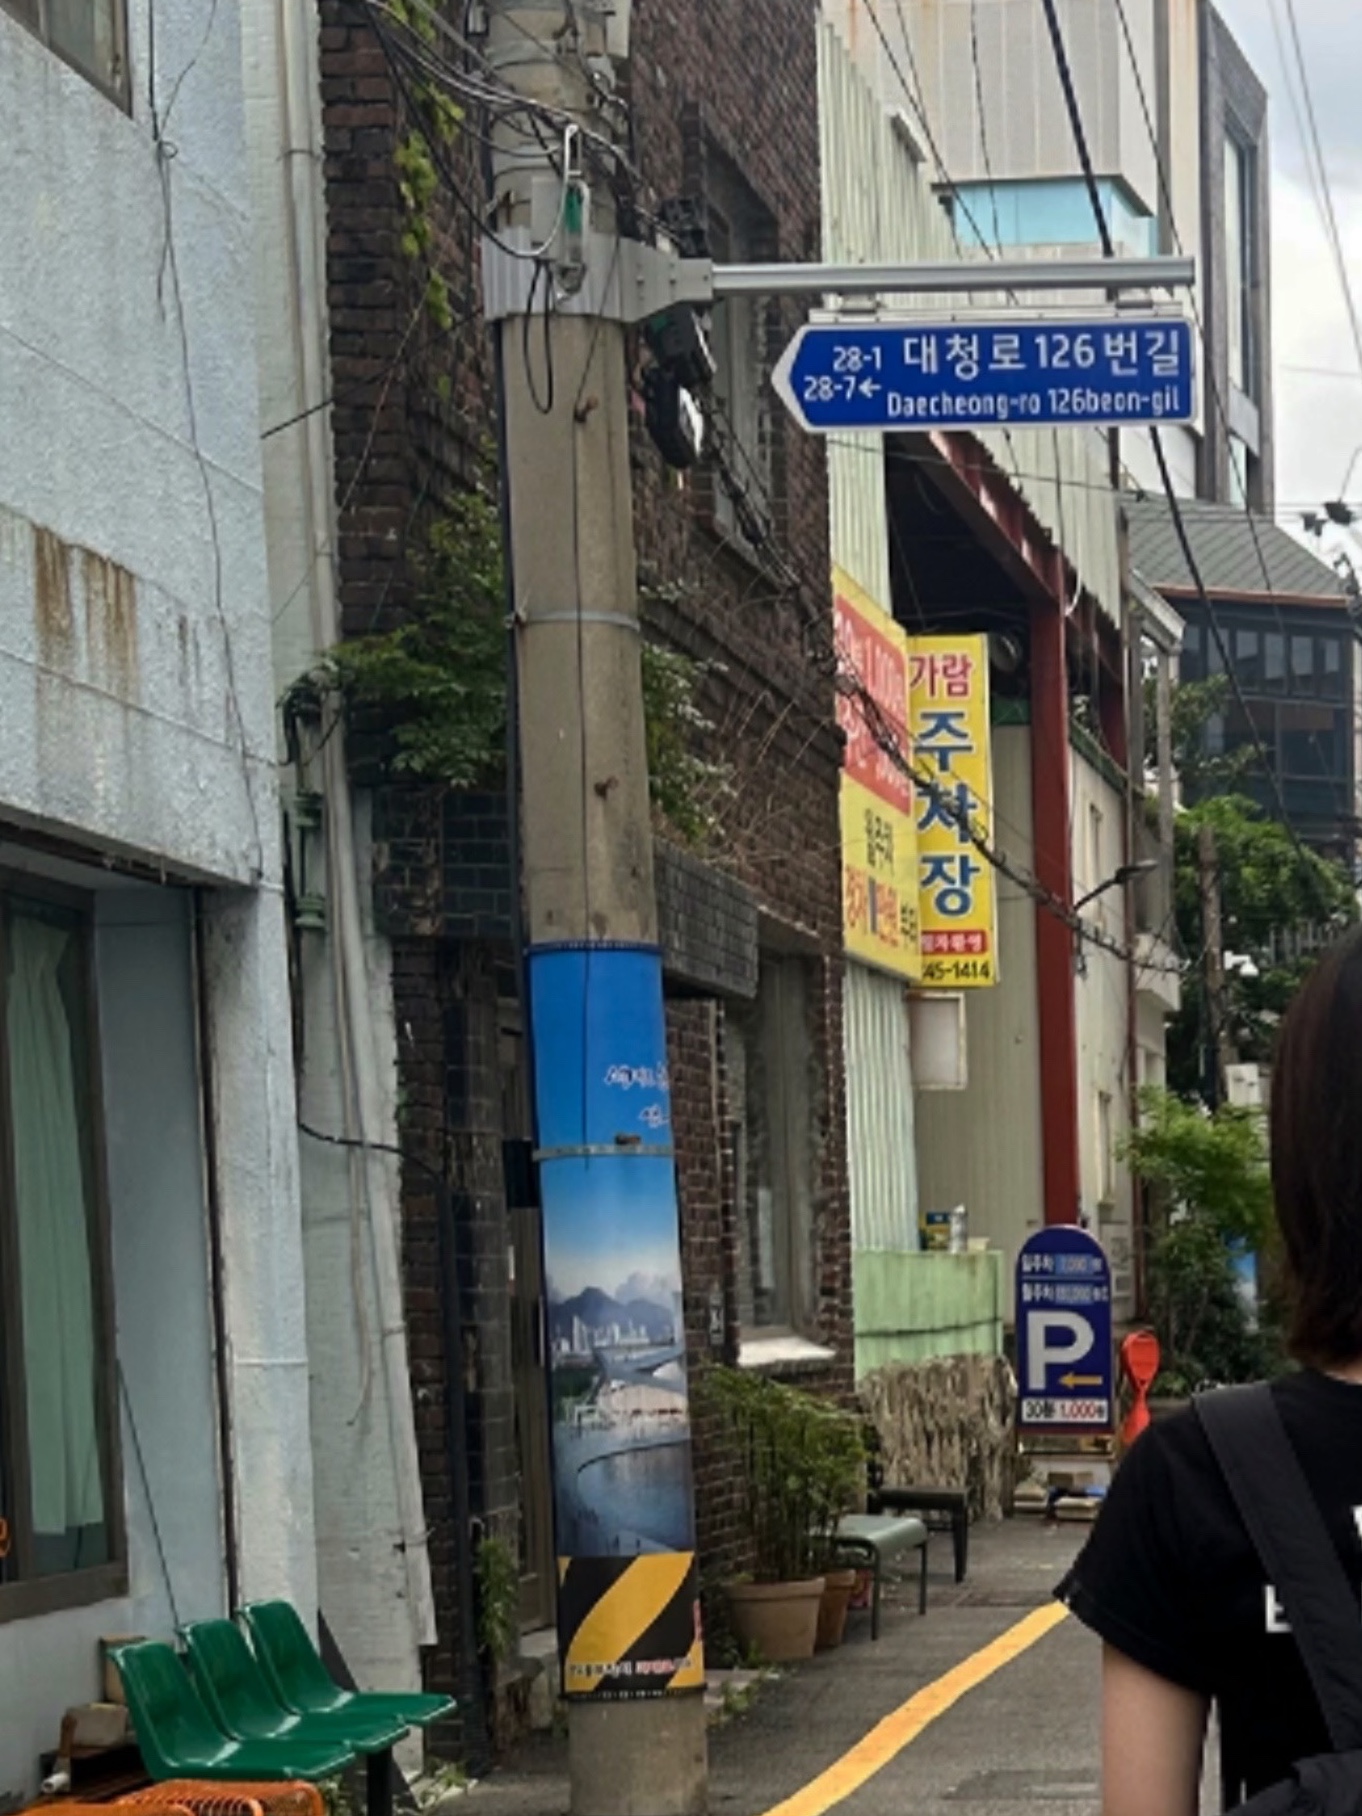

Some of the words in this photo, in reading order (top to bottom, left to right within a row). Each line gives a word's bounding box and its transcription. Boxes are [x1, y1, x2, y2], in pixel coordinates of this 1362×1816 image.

[833, 345, 882, 372] 28-1
[804, 374, 857, 402] 28-7
[887, 391, 1041, 420] Daecheong-ro
[1048, 385, 1180, 417] 126beon-gil
[909, 654, 972, 698] 가람
[915, 711, 981, 917] 주차장
[922, 960, 991, 981] 45-1414
[1027, 1310, 1094, 1391] P
